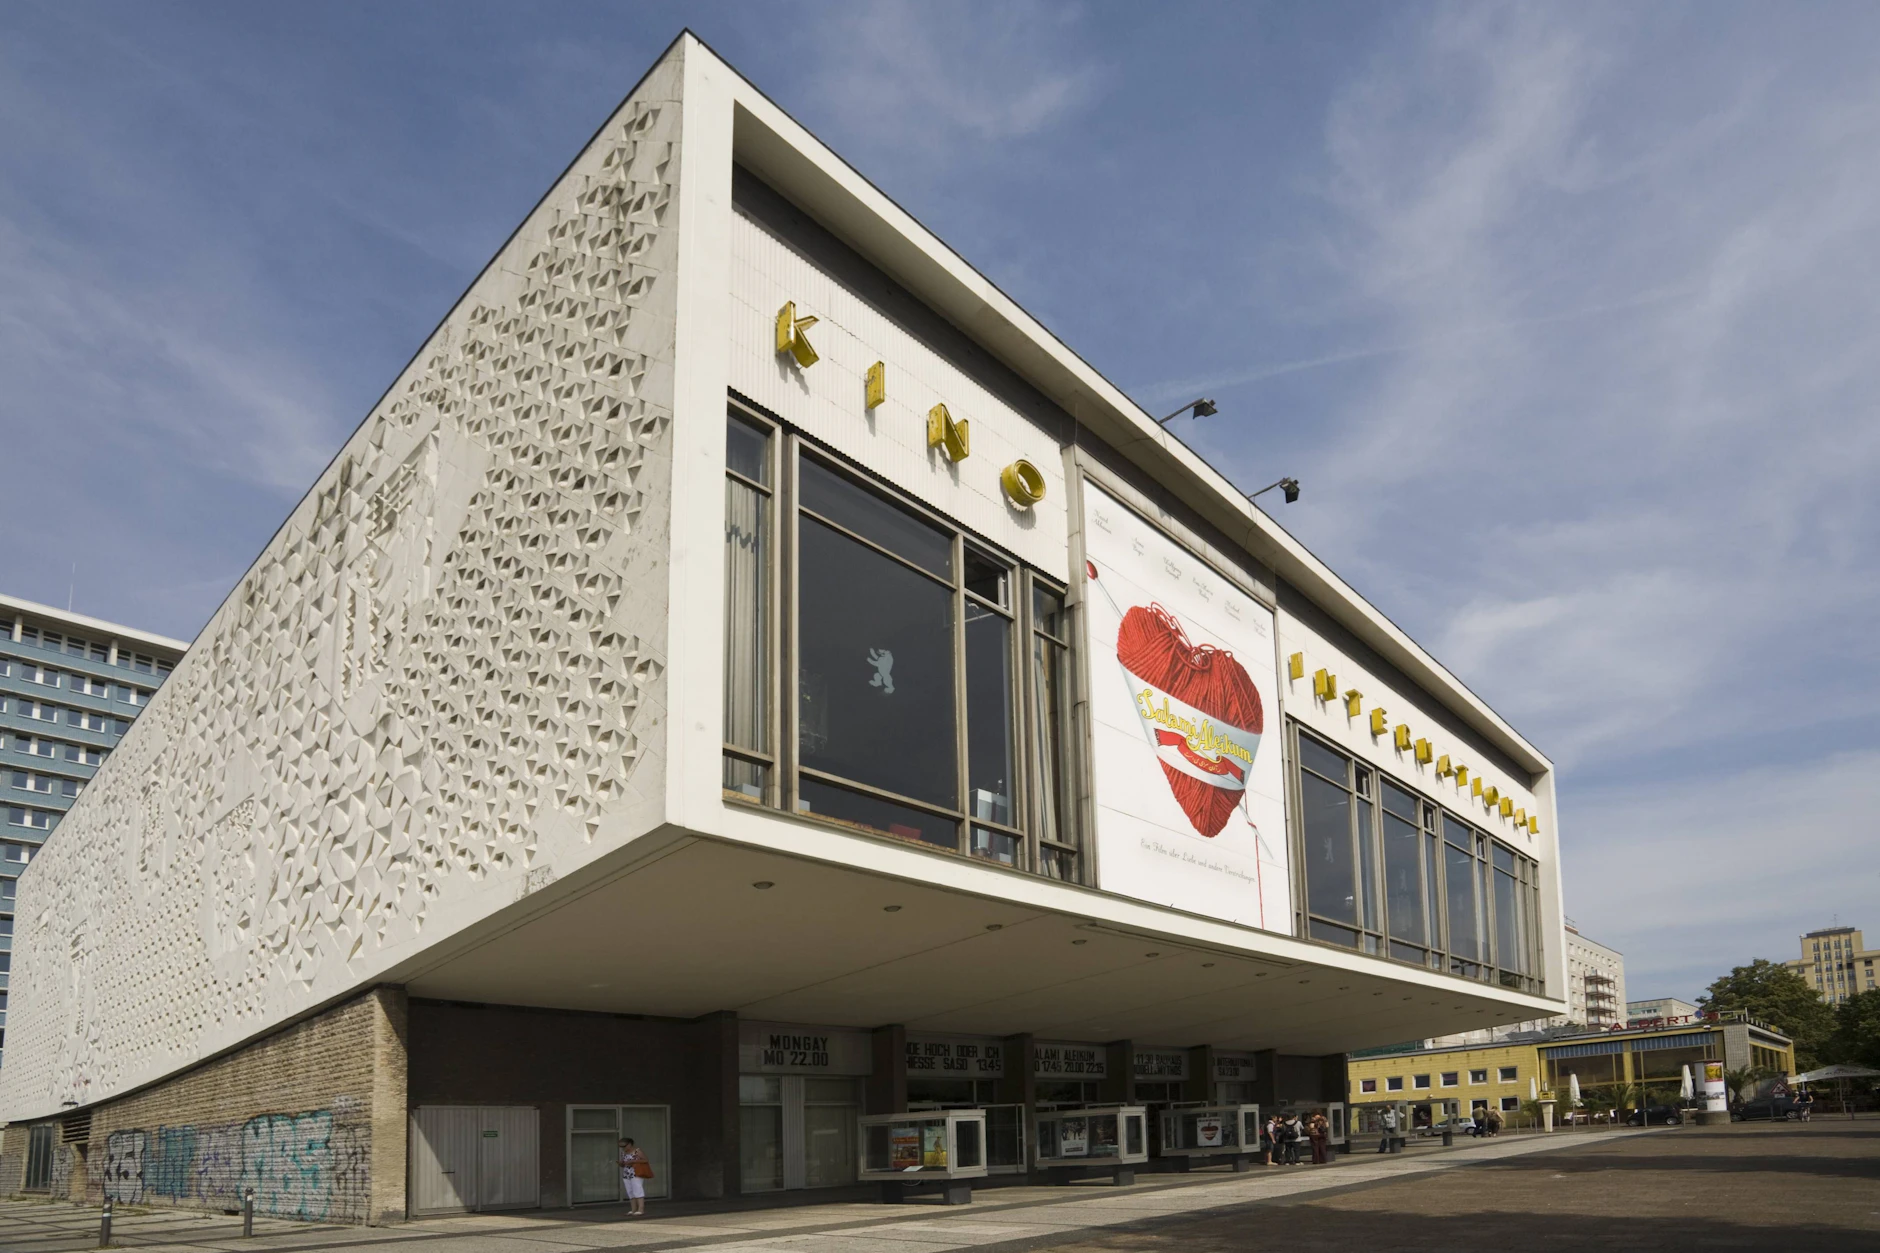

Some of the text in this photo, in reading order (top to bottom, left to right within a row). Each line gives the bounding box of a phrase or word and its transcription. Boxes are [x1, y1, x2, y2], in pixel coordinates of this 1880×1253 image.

[774, 300, 1540, 834] KINO INTERNATIONAL
[1137, 688, 1198, 740] Salami
[1186, 719, 1253, 765] Aleikum
[1152, 842, 1168, 856] Film
[1182, 852, 1197, 865] Liebe
[769, 1034, 828, 1051] MONGAY
[924, 1043, 950, 1056] HOCH
[956, 1045, 978, 1058] ODER
[985, 1046, 999, 1059] ICH
[764, 1050, 829, 1066] MO 22.00
[1064, 1050, 1095, 1062] ALEIKUM
